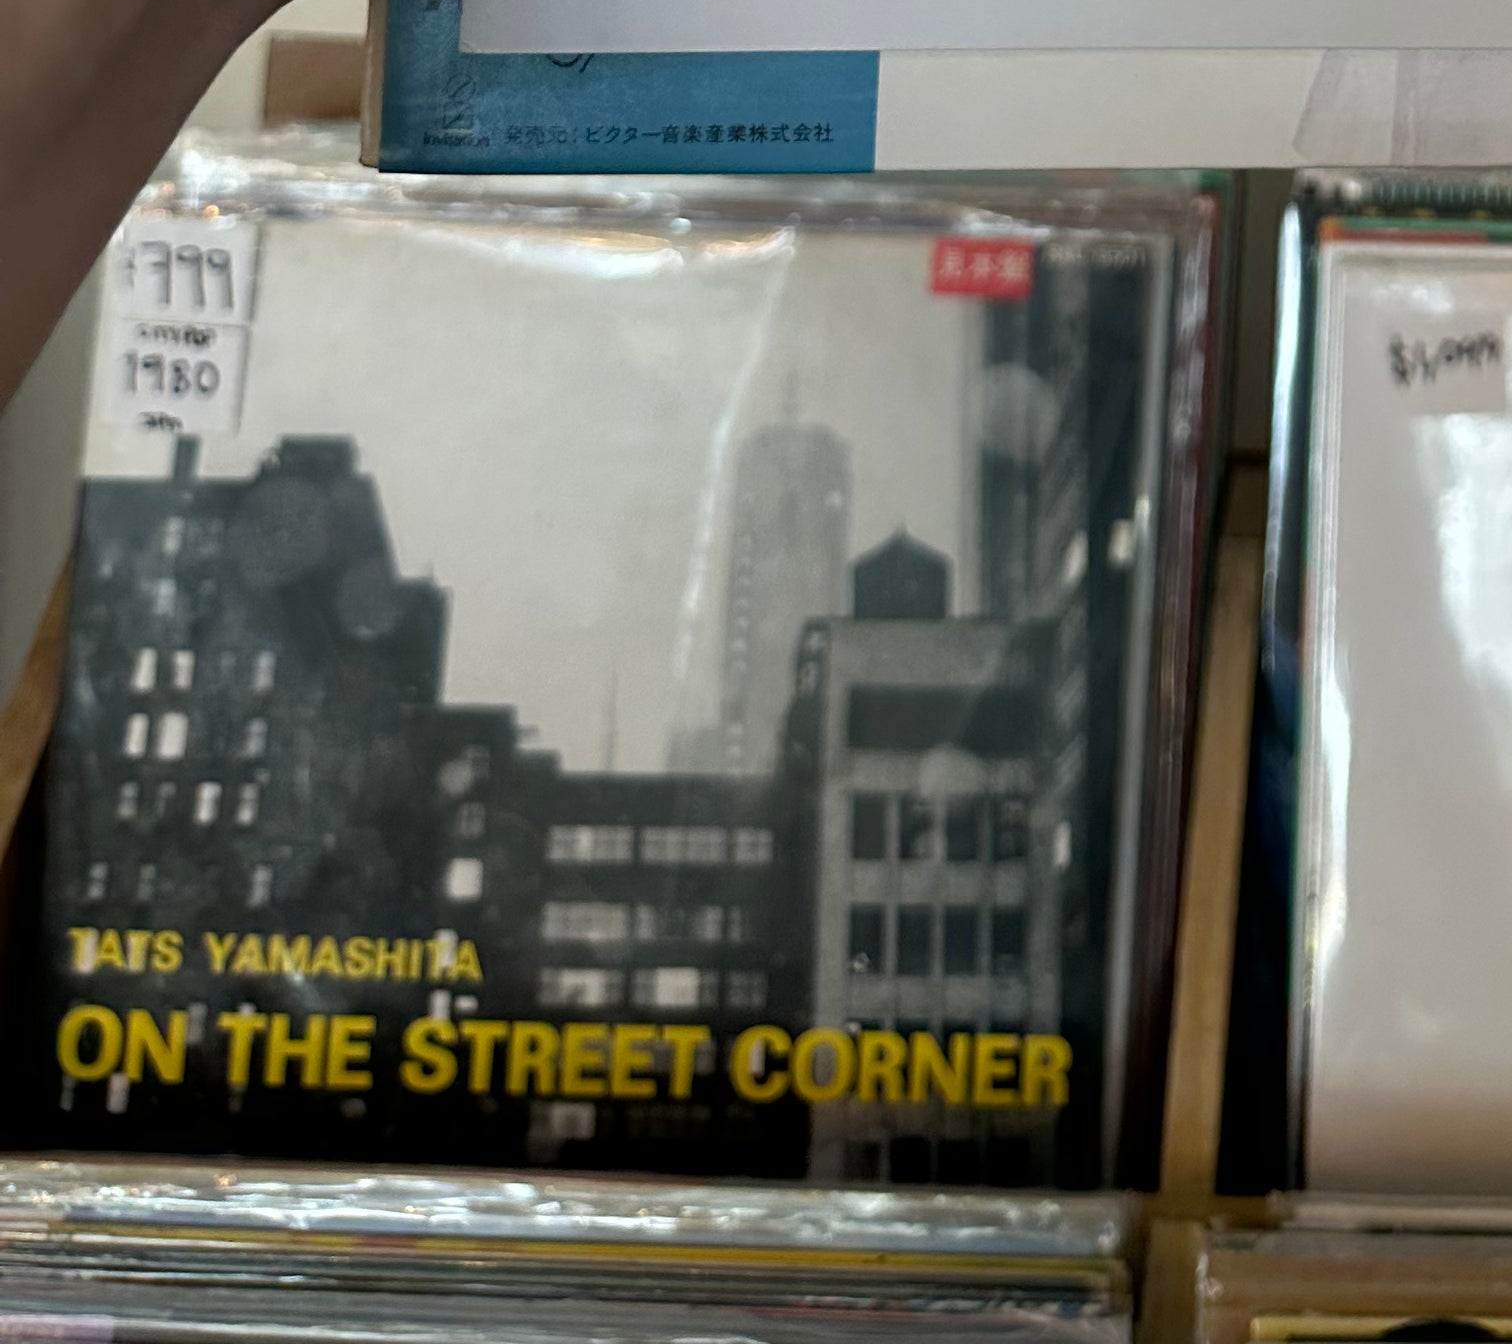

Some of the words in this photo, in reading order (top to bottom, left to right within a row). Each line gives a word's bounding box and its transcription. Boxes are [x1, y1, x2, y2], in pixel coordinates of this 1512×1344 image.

[67, 927, 182, 974] TATS
[205, 932, 482, 984] YAMASHITA
[56, 1006, 188, 1084] ON
[218, 1011, 376, 1090] THE
[401, 1014, 712, 1101] STREET
[731, 1024, 1073, 1107] CORNER
